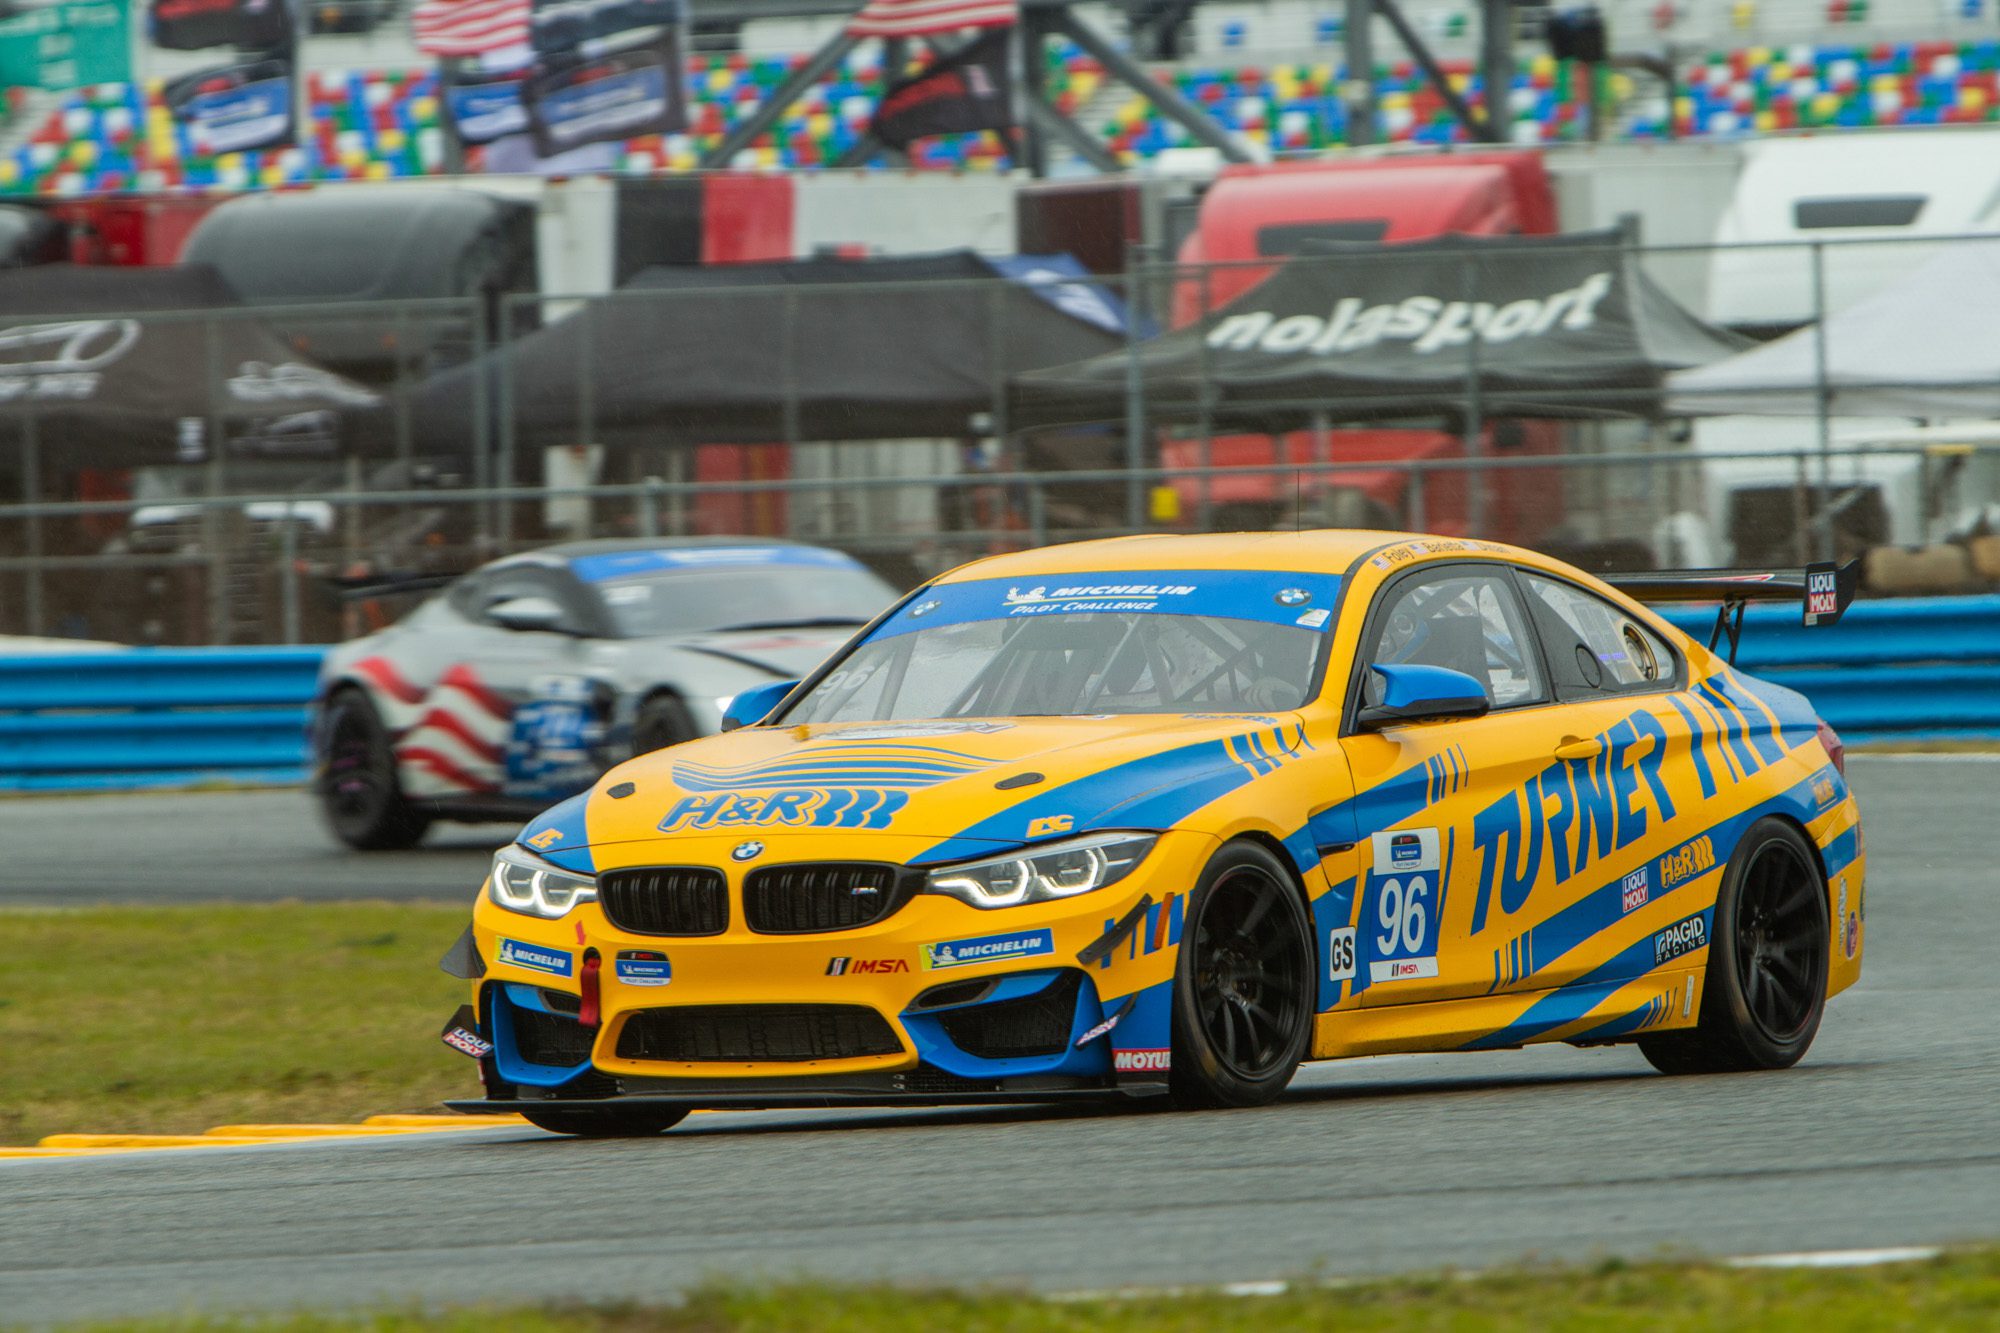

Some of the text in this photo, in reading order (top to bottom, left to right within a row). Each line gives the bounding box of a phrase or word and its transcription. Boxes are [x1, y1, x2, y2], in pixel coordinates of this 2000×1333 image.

[1206, 272, 1614, 354] nolasport
[1382, 546, 1415, 564] Foley
[1051, 586, 1196, 596] MICHELIN
[1810, 574, 1835, 592] LIQUI
[1010, 602, 1158, 615] PILOT CHALLENGE
[1811, 593, 1836, 612] MOLY
[816, 666, 875, 696] 96
[657, 790, 823, 833] H&R
[1470, 709, 1677, 936] TURNER
[1660, 844, 1698, 889] H&R
[1623, 870, 1646, 894] LIQUI
[1624, 886, 1647, 910] MOLY
[1377, 875, 1428, 956] 96
[1665, 917, 1704, 950] PAGID
[514, 949, 566, 968] MICHELIN
[958, 937, 1042, 958] MICHELIN
[1332, 935, 1353, 972] GS
[1656, 935, 1705, 964] RACING
[852, 959, 910, 974] IMSA
[444, 1034, 485, 1057] MOLY
[453, 1028, 492, 1051] LIQUI
